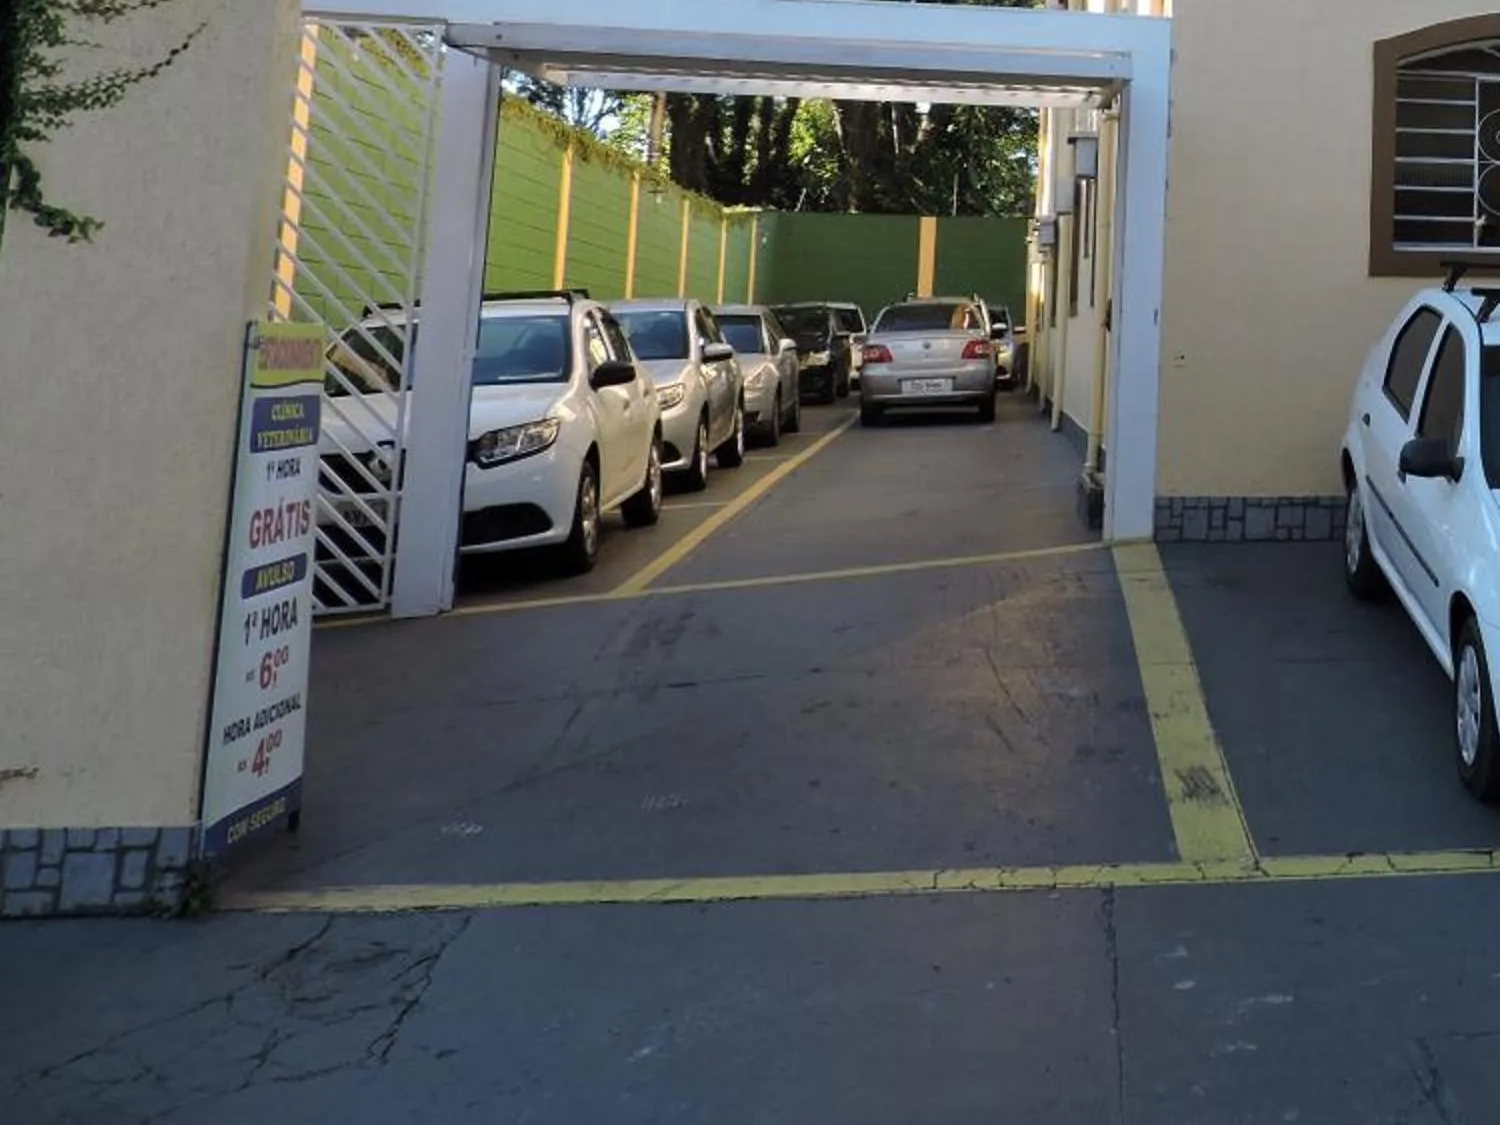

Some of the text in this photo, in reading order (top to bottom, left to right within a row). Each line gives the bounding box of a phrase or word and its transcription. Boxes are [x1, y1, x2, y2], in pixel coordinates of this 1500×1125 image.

[276, 457, 301, 481] HORA
[249, 497, 310, 549] GRÁTIS
[256, 561, 295, 591] AVULSO
[260, 597, 298, 641] HORA
[223, 692, 302, 746] HORA ADICIONAL
